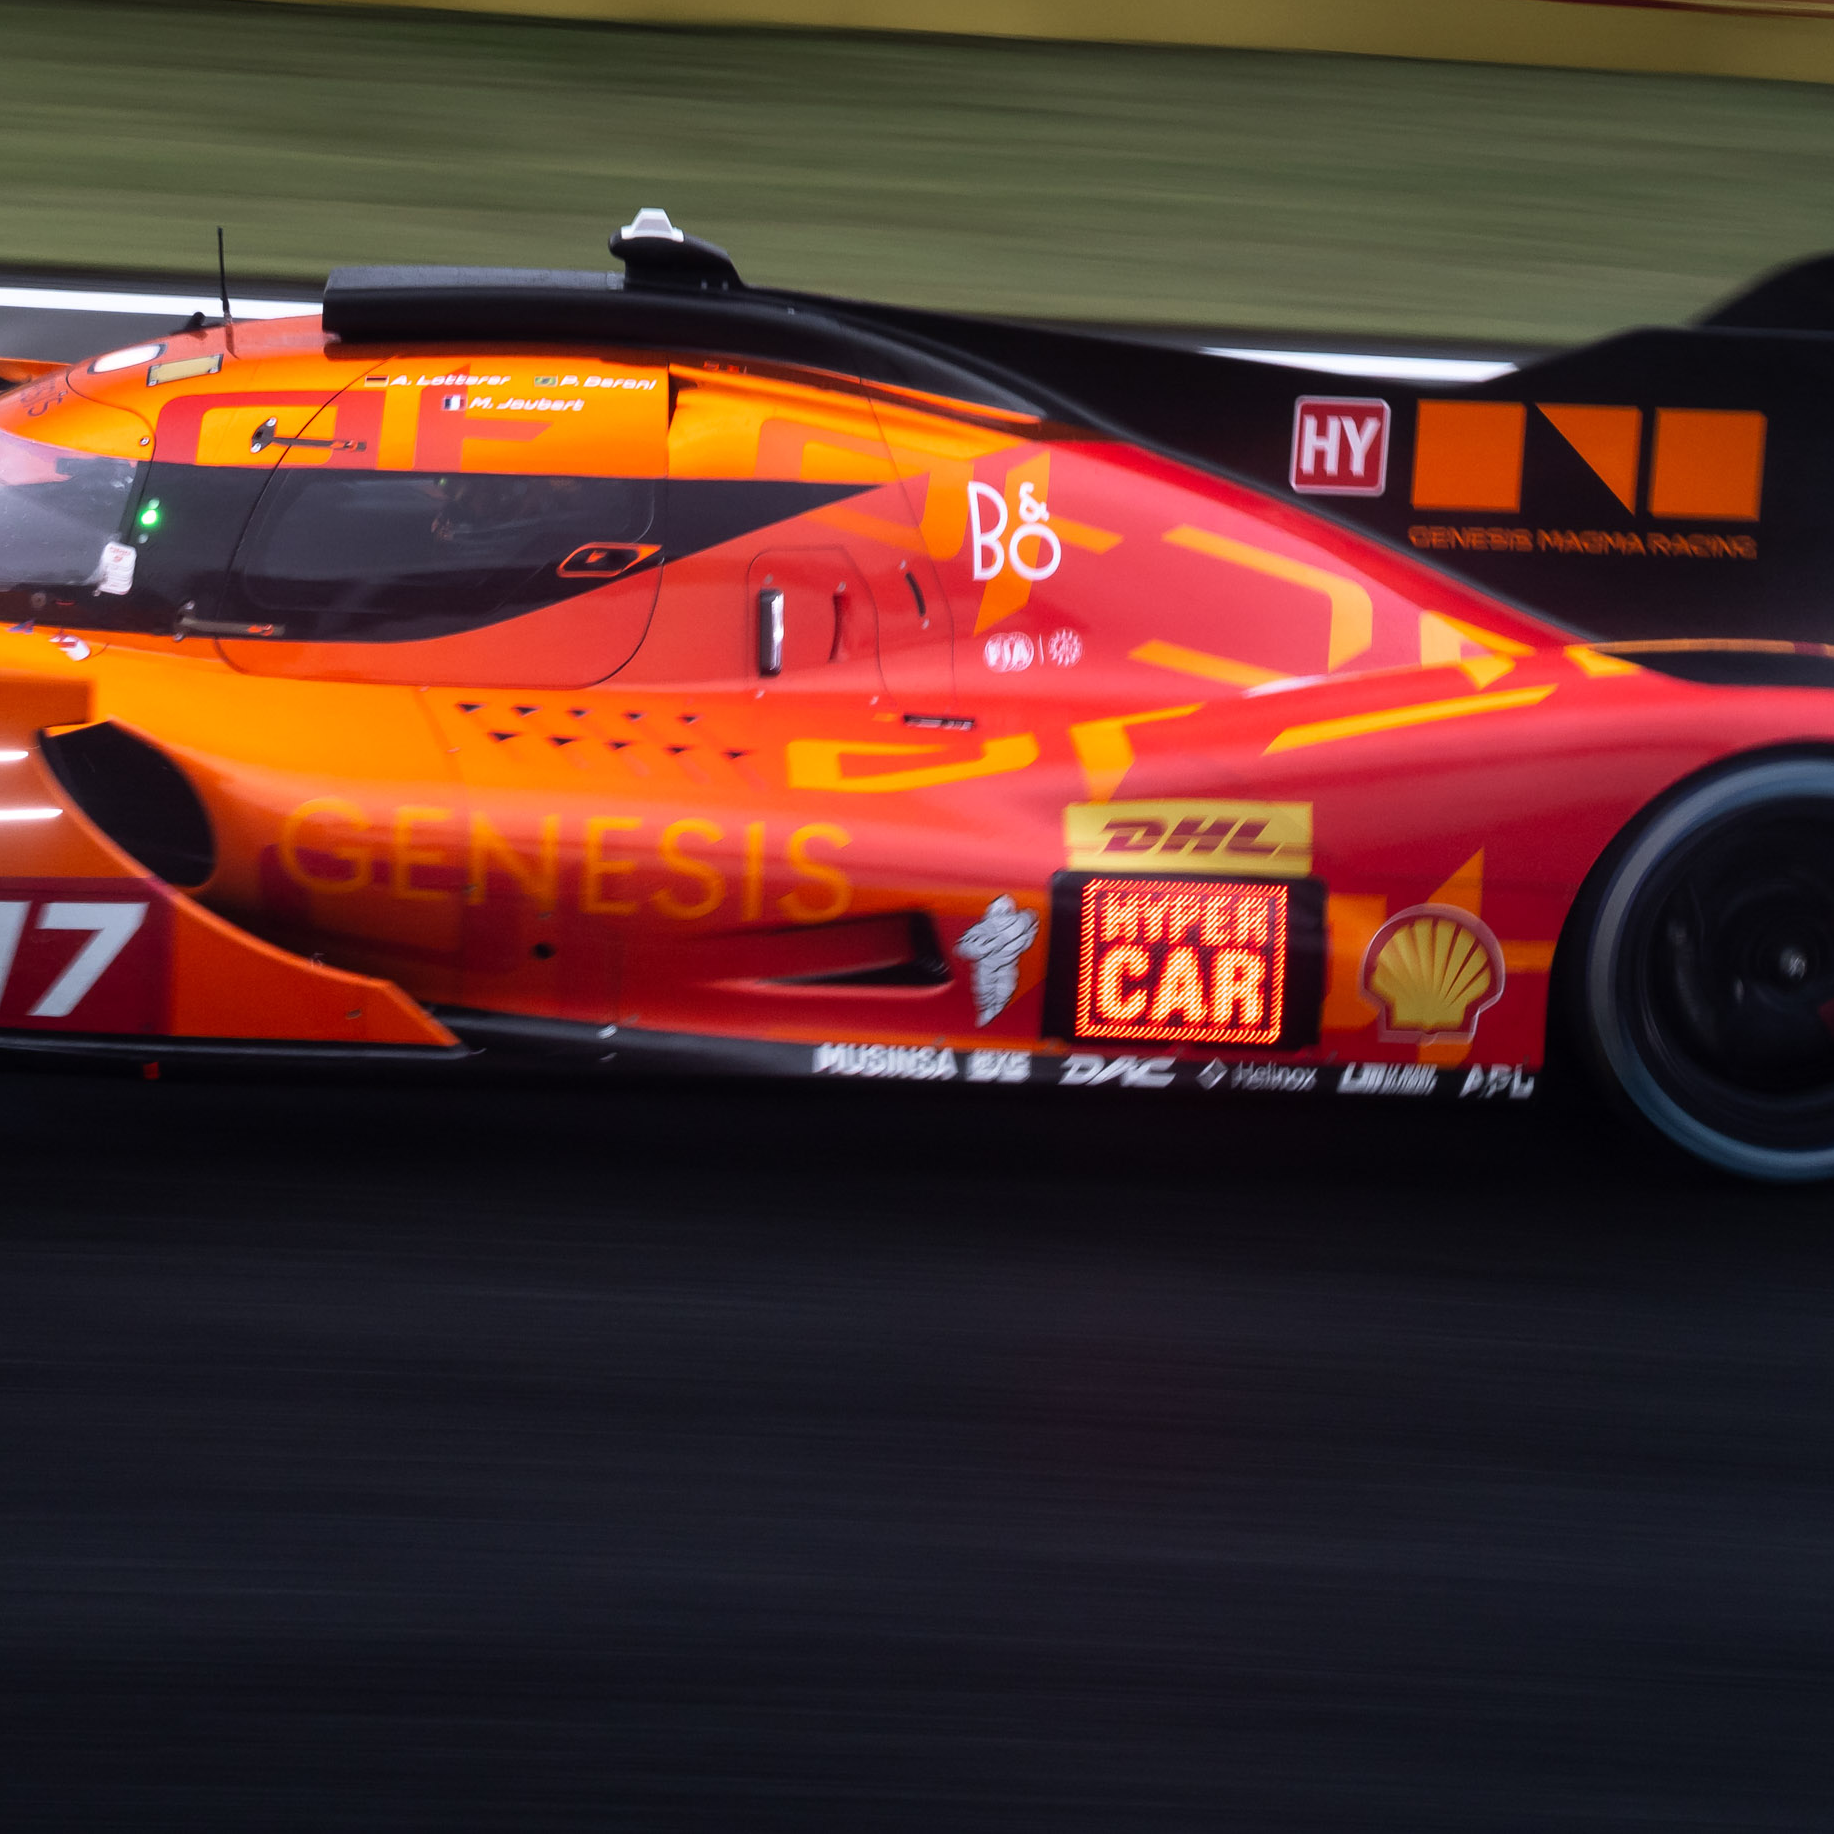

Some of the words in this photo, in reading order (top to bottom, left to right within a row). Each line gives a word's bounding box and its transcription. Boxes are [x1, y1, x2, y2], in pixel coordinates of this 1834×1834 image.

[390, 375, 412, 387] A.
[416, 375, 511, 387] Lotterer
[560, 375, 580, 387] P.
[583, 376, 657, 391] Derani
[469, 396, 494, 410] M.
[496, 397, 584, 412] Jaubert
[1300, 414, 1381, 477] HY
[1407, 525, 1533, 552] GENESIS
[1537, 529, 1646, 556] MAGMA
[1647, 532, 1758, 560] RACING
[1100, 819, 1282, 853] DHL
[277, 796, 853, 923] GENESIS
[1101, 892, 1268, 946] HYPER
[1096, 944, 1268, 1026] CAR
[813, 1042, 959, 1080] MUSINSA
